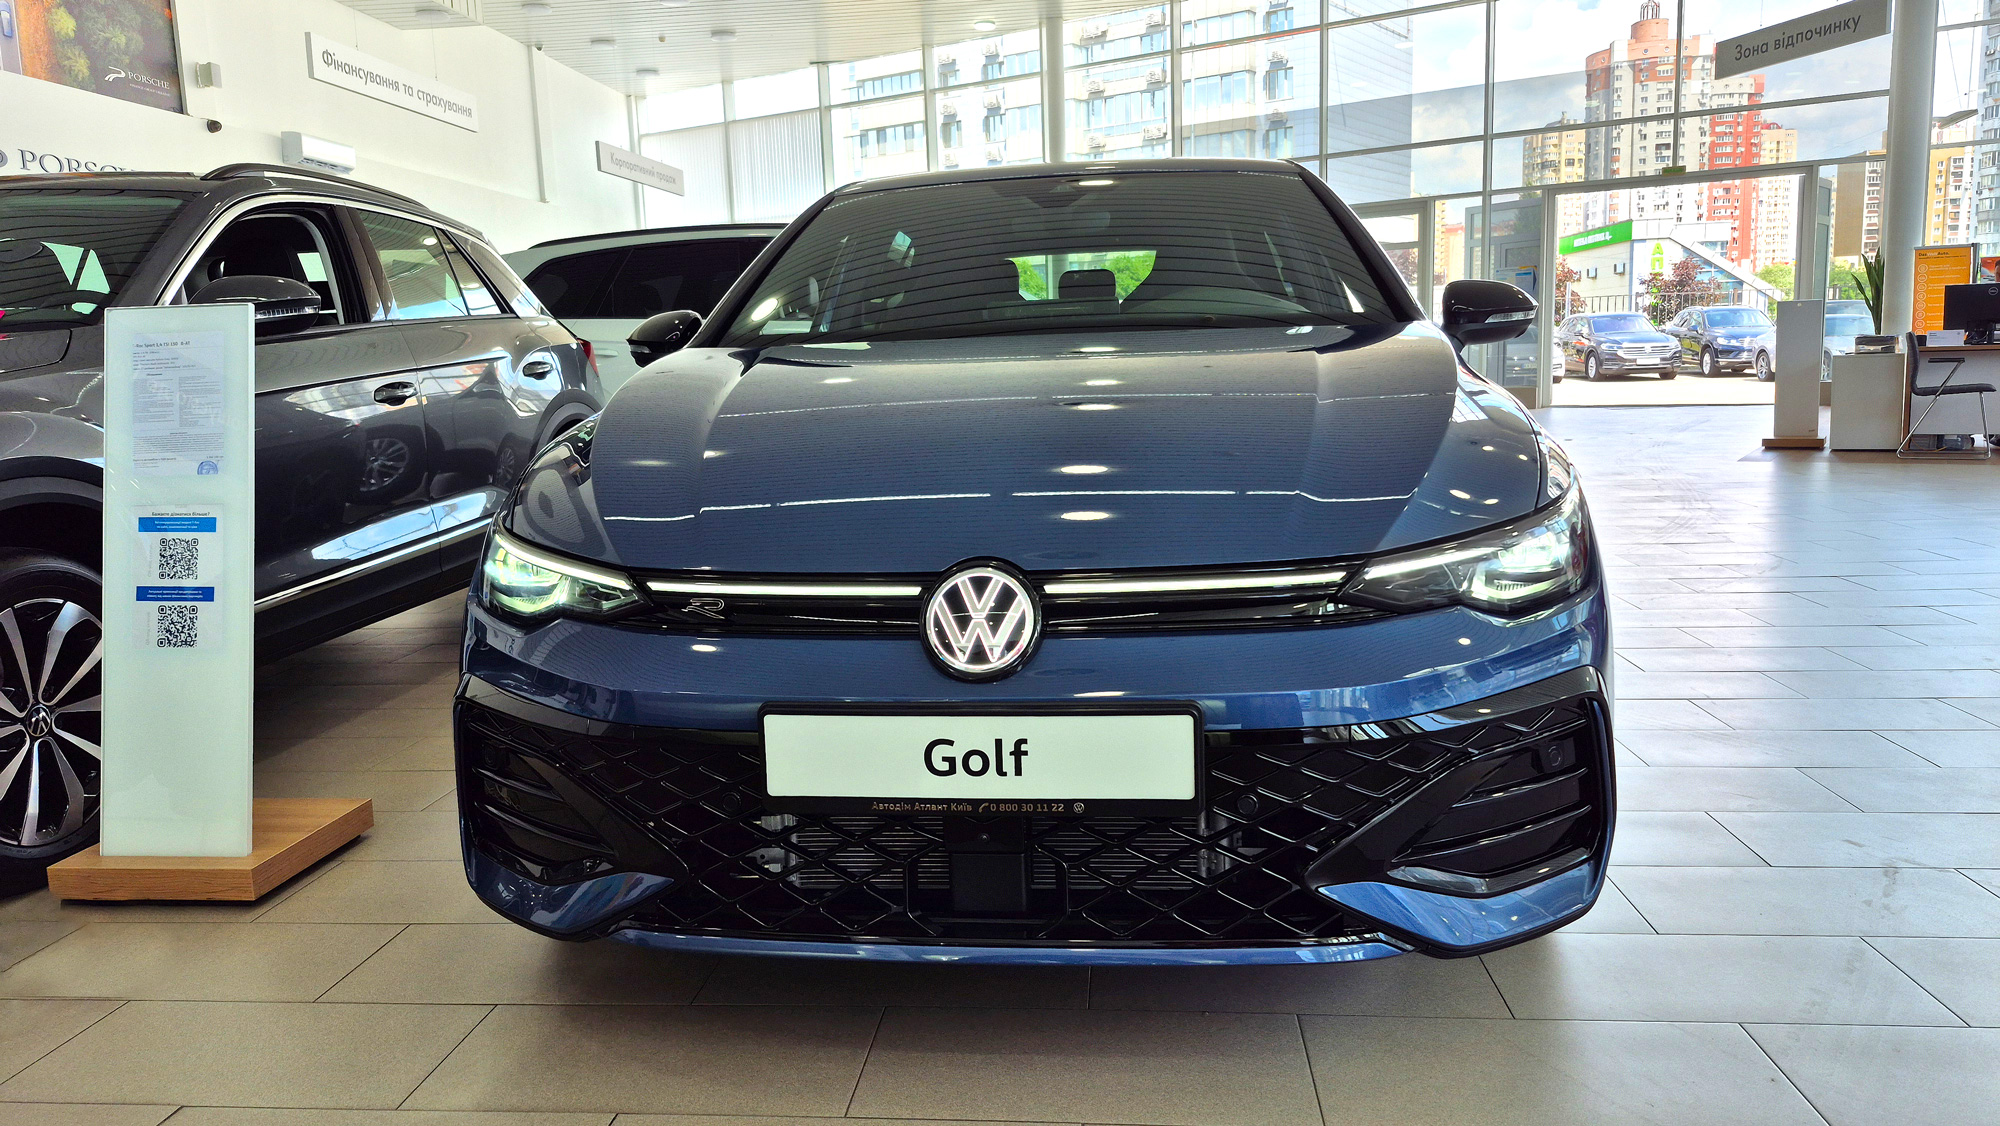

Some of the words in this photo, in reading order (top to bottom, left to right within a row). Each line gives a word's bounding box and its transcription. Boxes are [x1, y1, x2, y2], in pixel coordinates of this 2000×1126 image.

[1734, 43, 1769, 61] Зона
[1773, 14, 1862, 51] відпочинку
[127, 71, 170, 90] PORSCHE
[321, 48, 400, 92] Фінансування
[402, 82, 414, 97] та
[416, 88, 473, 119] страхування
[609, 151, 656, 178] Корпоративний
[923, 738, 1029, 777] Golf
[871, 801, 912, 812] Автодім
[913, 802, 948, 811] Атлант
[950, 802, 973, 812] Київ
[990, 803, 997, 812] 0
[999, 803, 1019, 812] 800
[1020, 803, 1034, 812] 30
[1036, 803, 1049, 812] 11
[1051, 803, 1065, 812] 22
